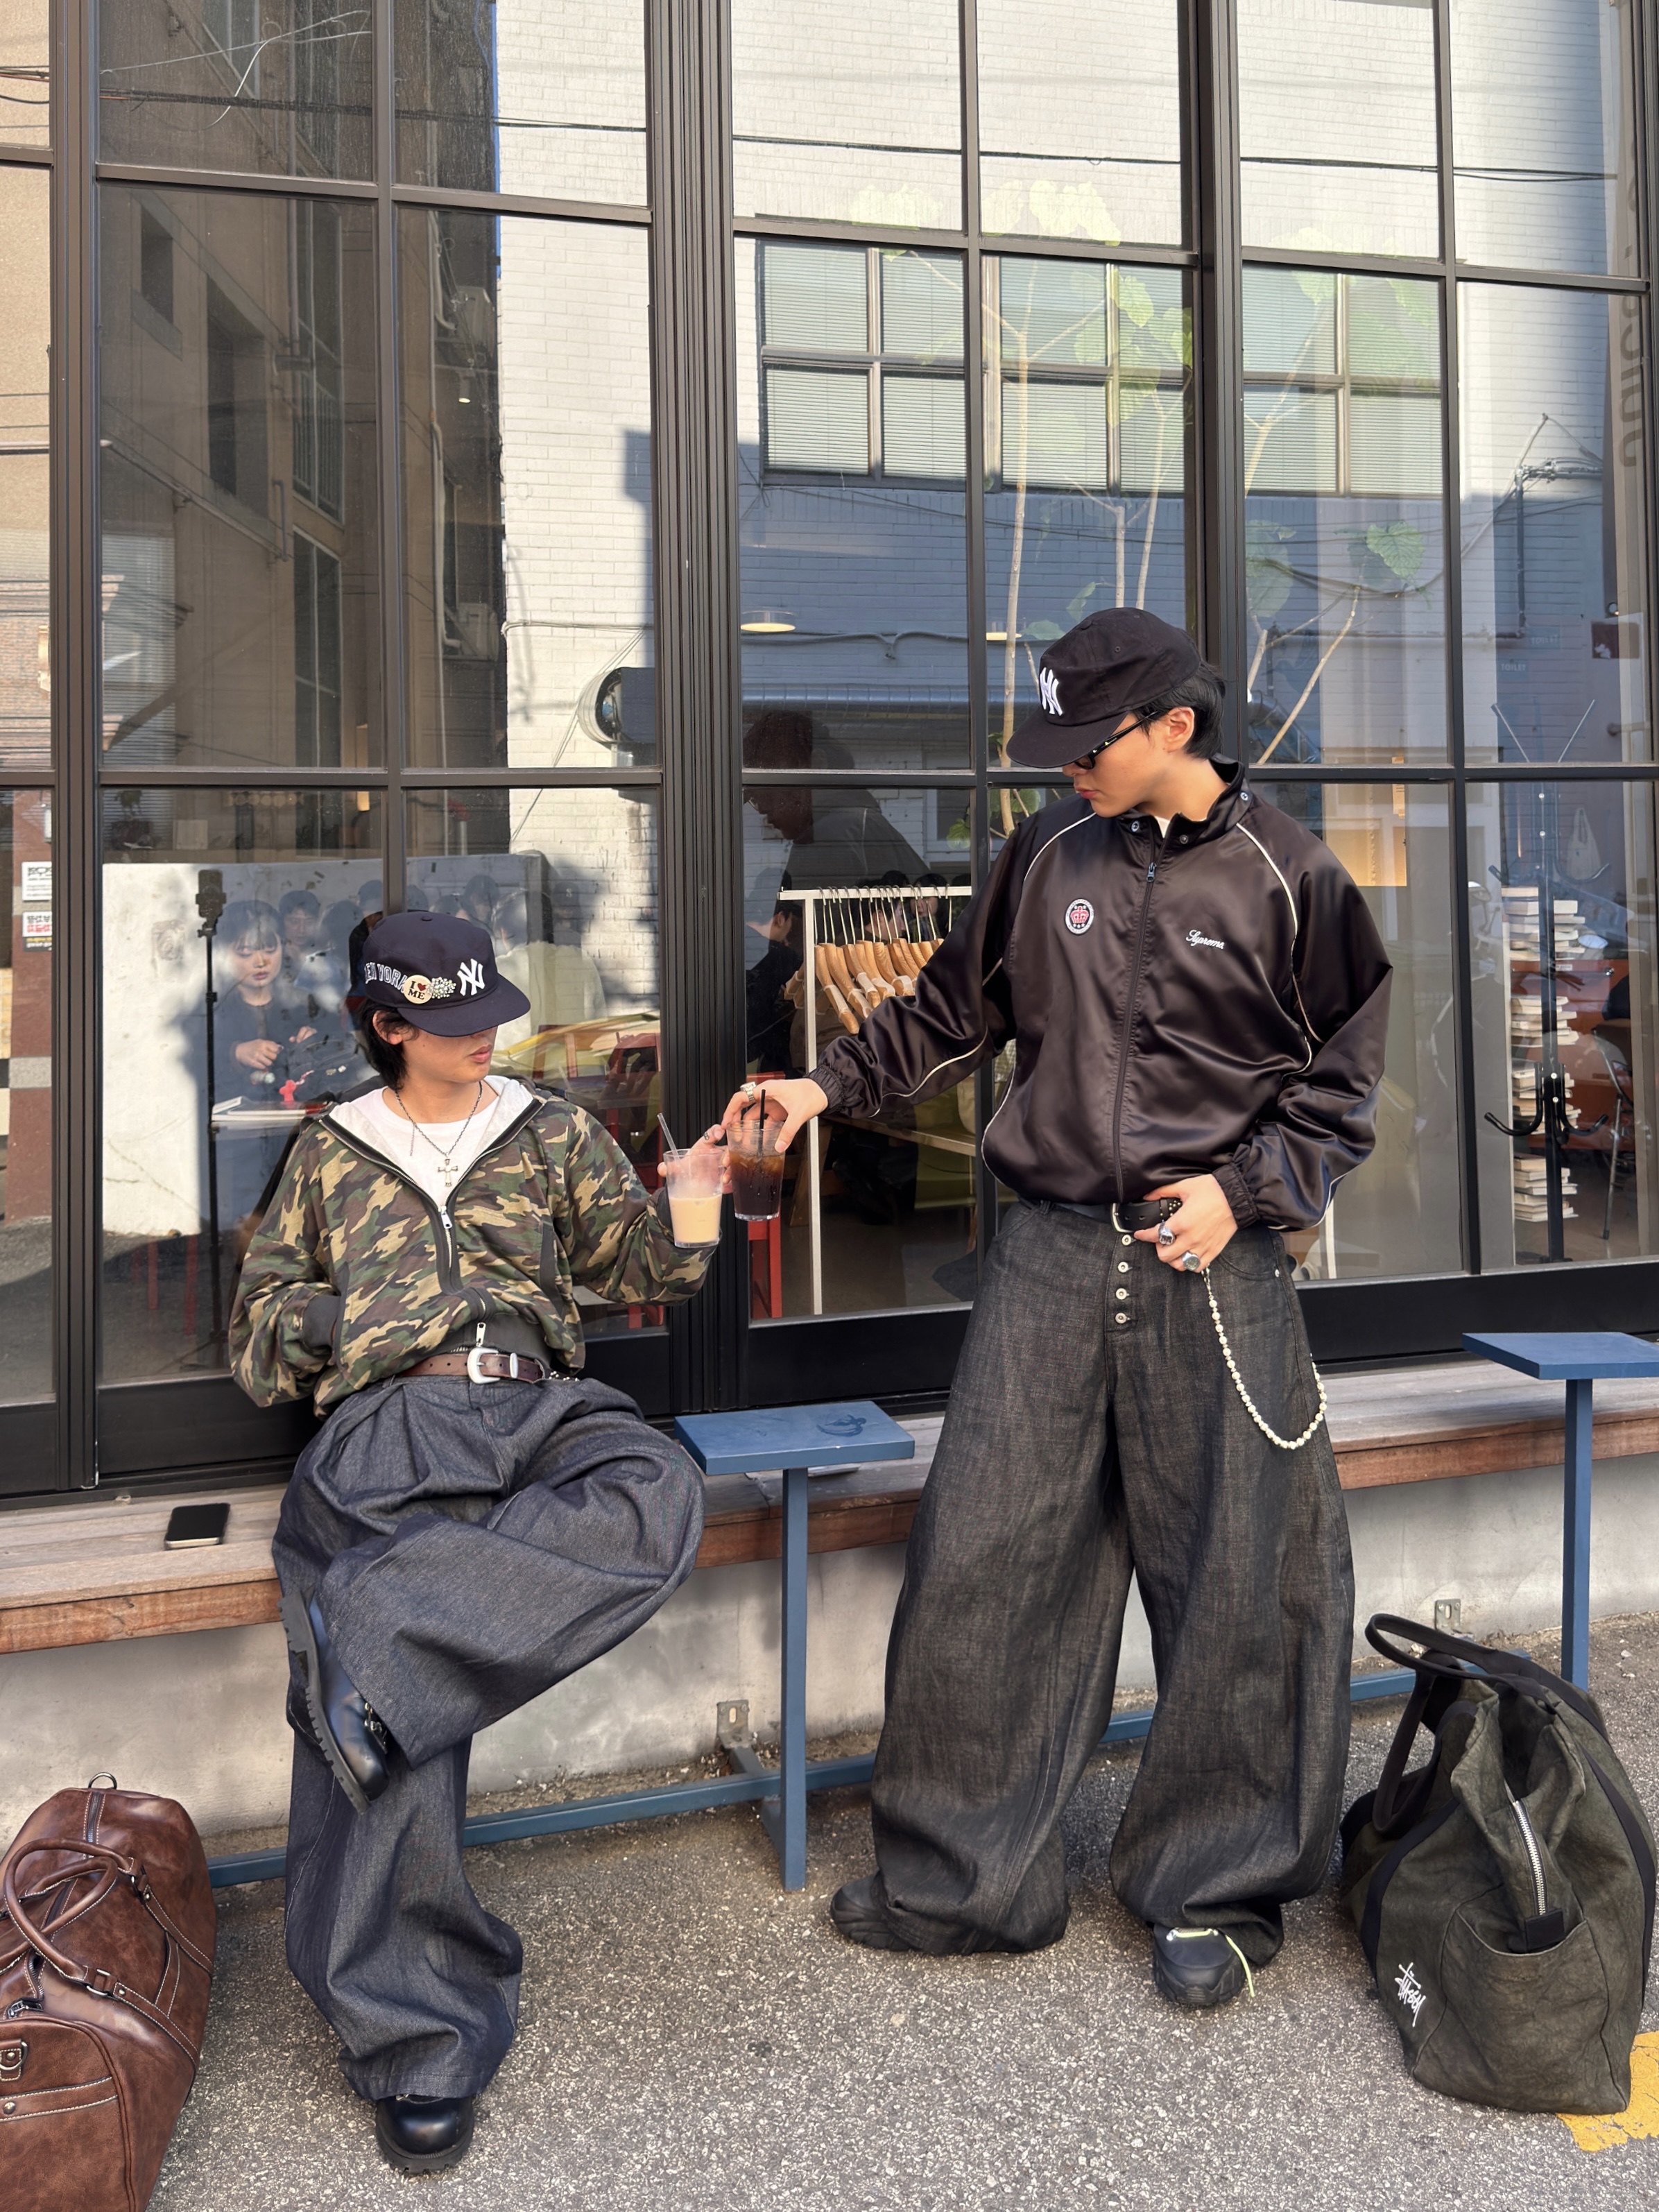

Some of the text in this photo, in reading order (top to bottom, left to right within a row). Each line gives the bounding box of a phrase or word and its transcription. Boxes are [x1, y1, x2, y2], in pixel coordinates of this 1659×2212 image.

[1500, 663, 1527, 672] TOILET
[1186, 929, 1225, 950] Supreme
[457, 958, 485, 996] NY
[410, 980, 416, 989] I
[408, 988, 425, 1000] ME
